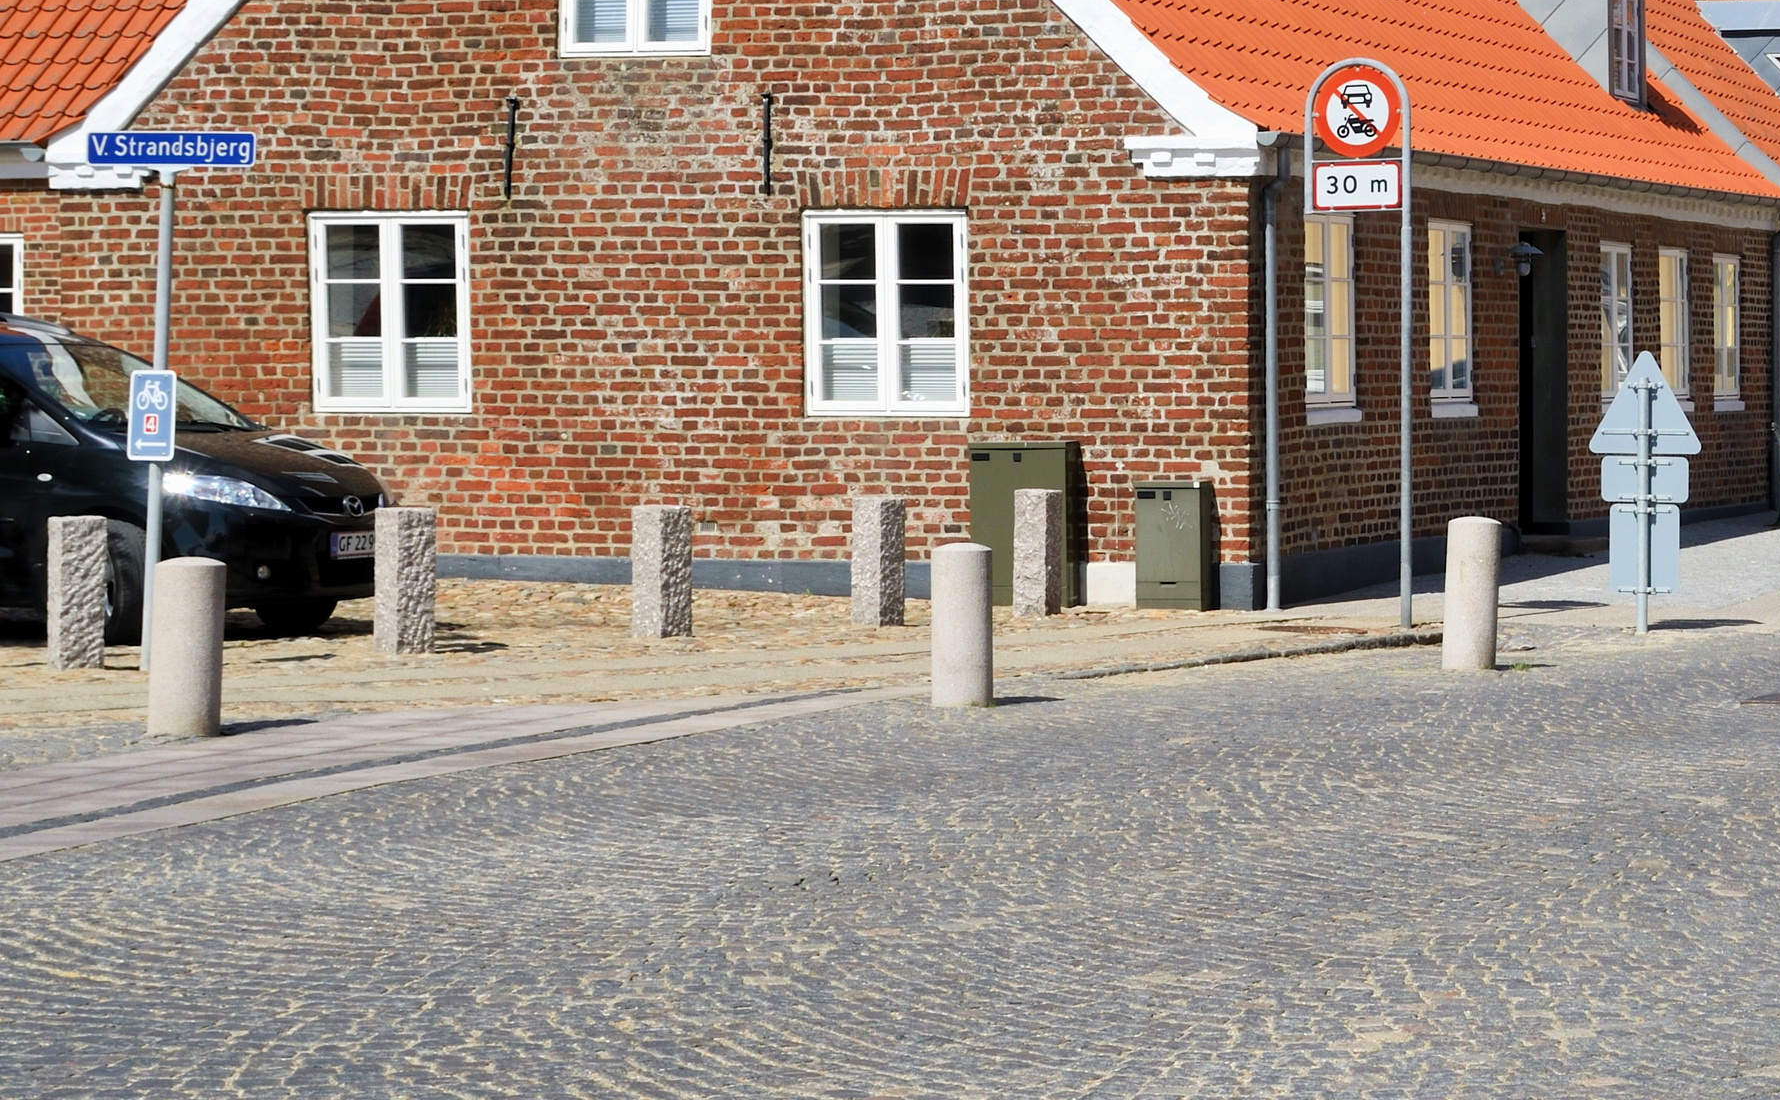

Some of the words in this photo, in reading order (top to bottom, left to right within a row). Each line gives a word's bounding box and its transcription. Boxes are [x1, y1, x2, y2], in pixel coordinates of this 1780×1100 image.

[91, 135, 108, 156] V.
[114, 135, 251, 163] Strandsbjerg
[1326, 175, 1357, 194] 30
[1370, 179, 1388, 192] m
[146, 417, 156, 432] 4
[339, 535, 353, 552] GF
[355, 534, 366, 550] 22
